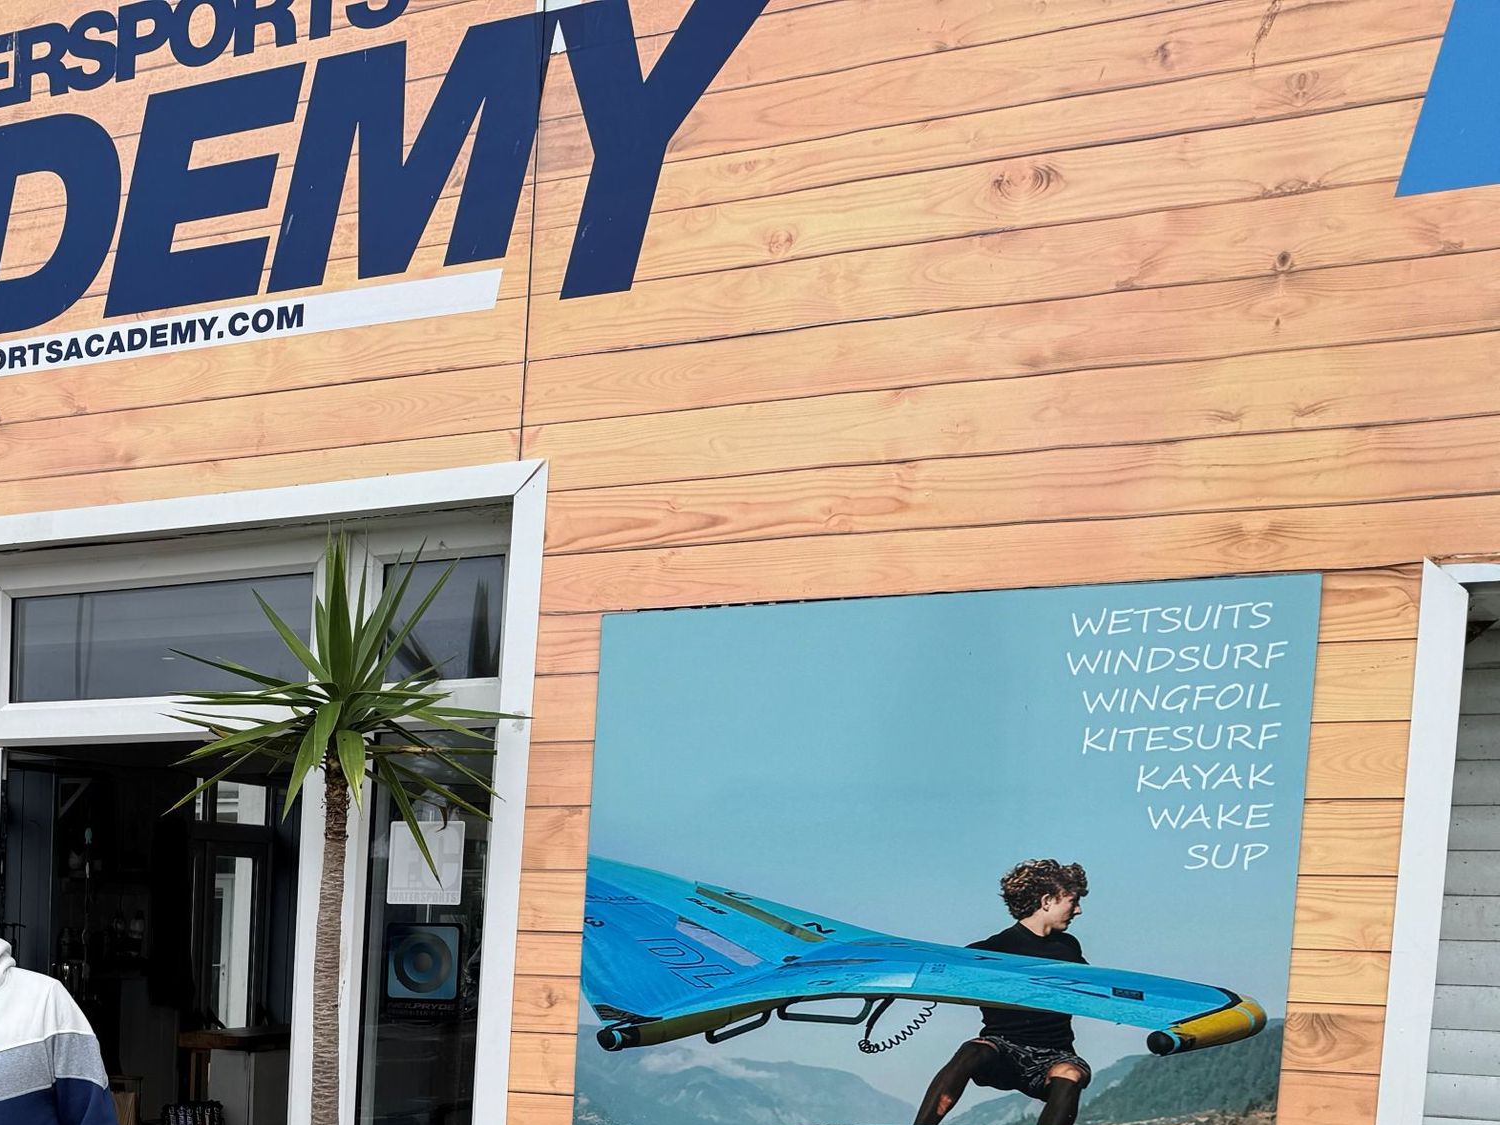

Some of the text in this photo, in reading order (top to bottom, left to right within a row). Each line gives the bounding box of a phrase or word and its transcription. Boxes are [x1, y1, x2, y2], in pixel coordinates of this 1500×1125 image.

[1071, 602, 1273, 637] WETSUITS
[1066, 641, 1289, 675] WINDSURF
[1082, 683, 1281, 714] WINGFOIL
[1082, 723, 1282, 754] KITESURF
[1136, 763, 1275, 792] KAYAK
[1147, 803, 1274, 830] WAKE
[1184, 843, 1268, 871] SUP
